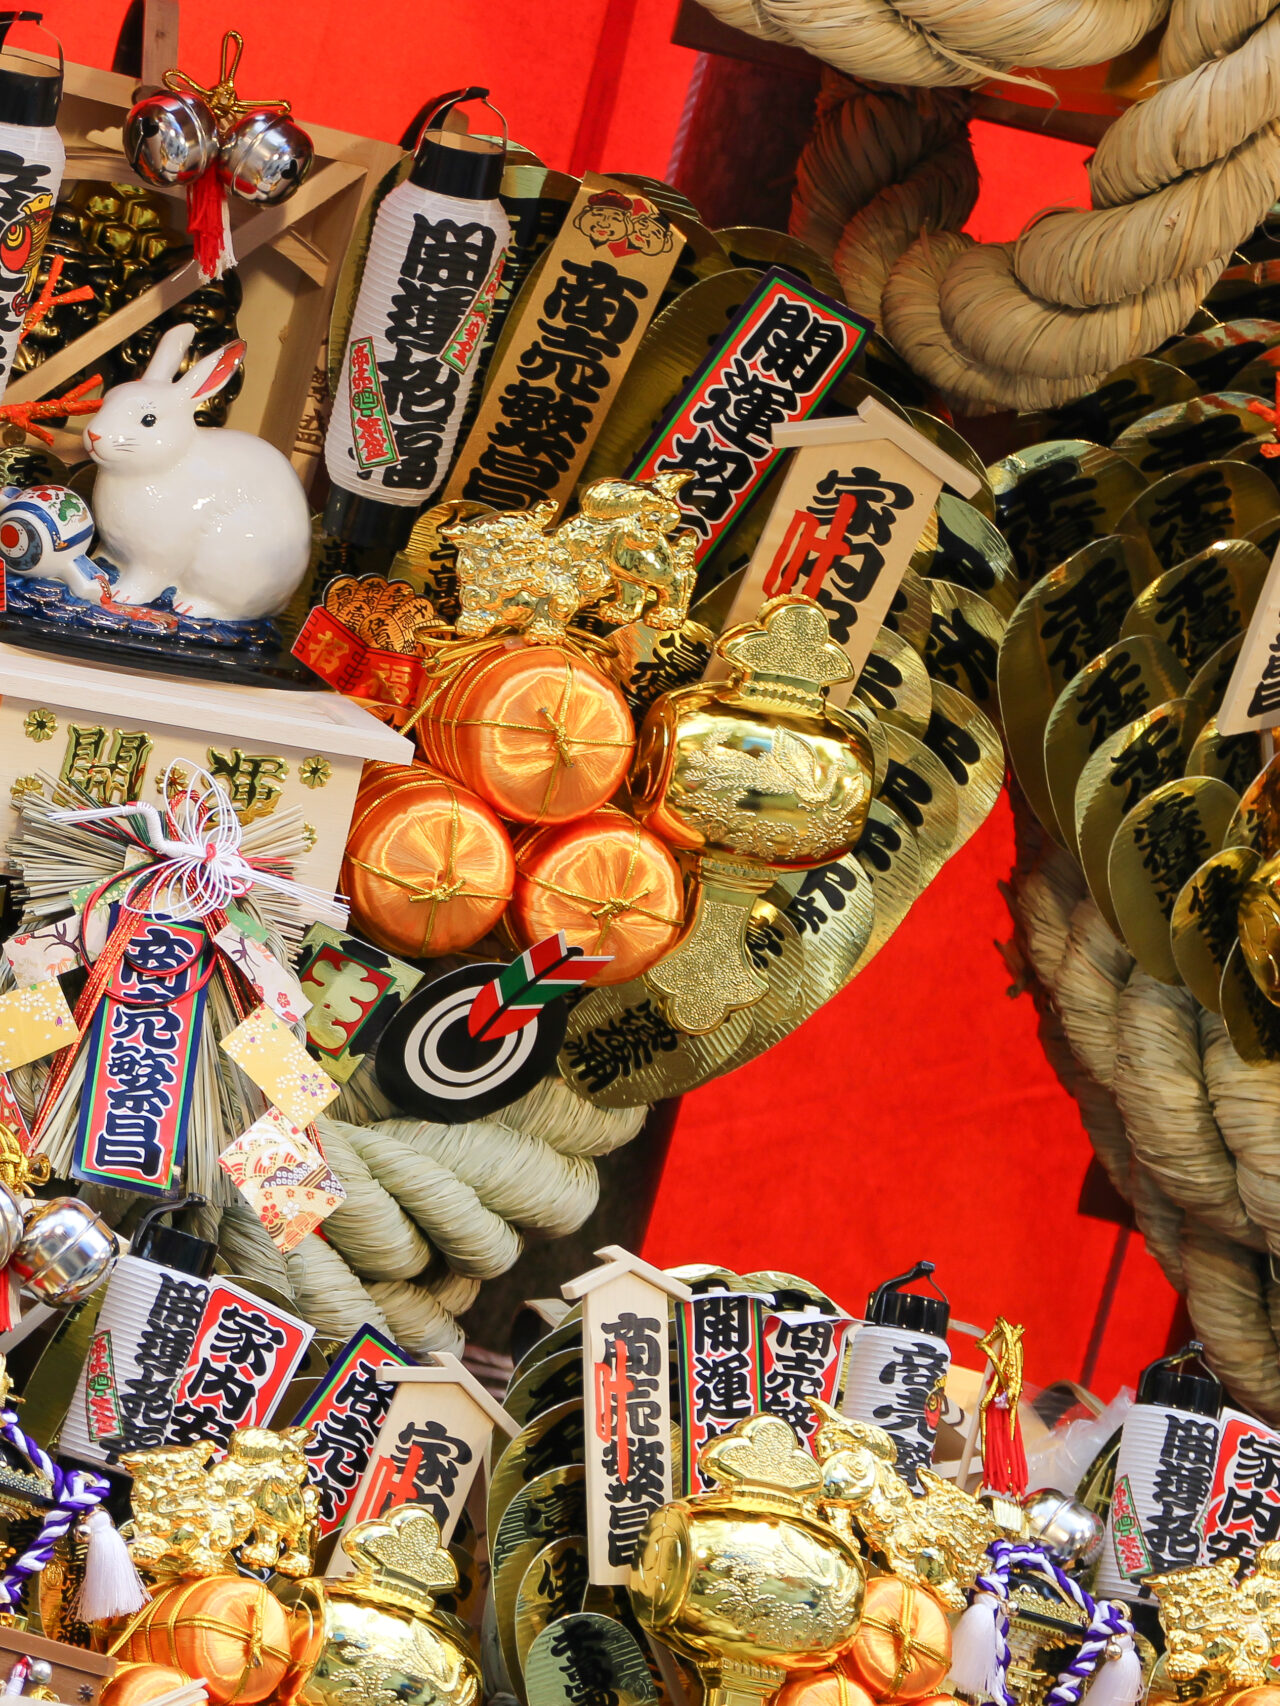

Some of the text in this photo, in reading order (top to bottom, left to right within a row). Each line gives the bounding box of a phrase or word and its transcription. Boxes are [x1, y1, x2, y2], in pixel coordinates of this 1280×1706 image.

[349, 212, 497, 489] 開運招福
[462, 258, 649, 511] 商売繁昌
[655, 296, 847, 541] 開運招
[53, 723, 290, 827] 開運
[96, 929, 196, 1178] 商売繁昌
[301, 1360, 398, 1521] 商売
[599, 1312, 666, 1569] 商売繁昌
[694, 1298, 751, 1460] 開運
[1135, 1414, 1219, 1599] 開運招
